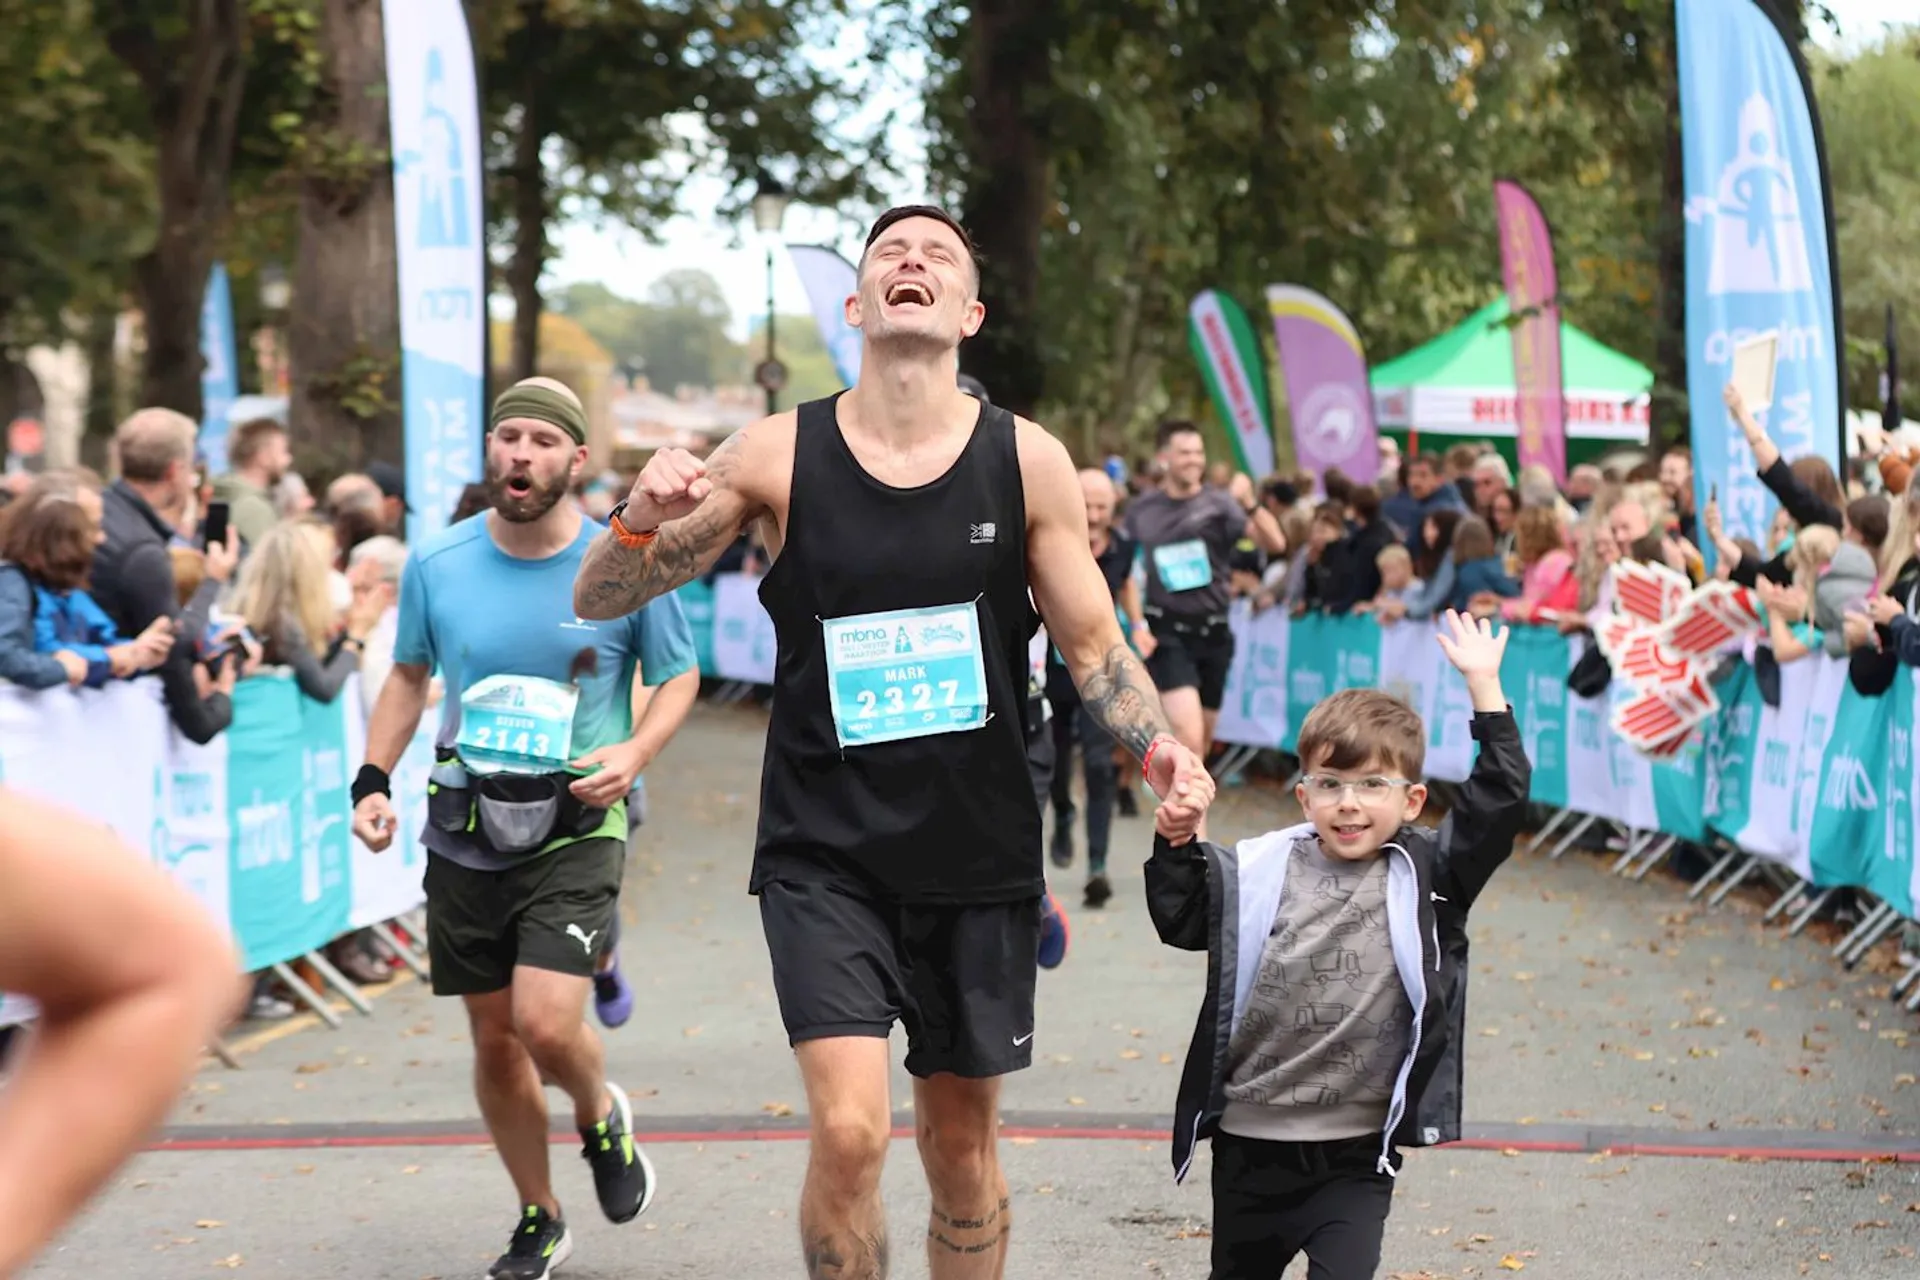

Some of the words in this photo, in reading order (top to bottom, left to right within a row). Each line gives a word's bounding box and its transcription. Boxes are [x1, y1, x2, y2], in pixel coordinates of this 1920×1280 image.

[840, 627, 887, 644] mbna
[884, 665, 927, 683] MARK
[857, 680, 959, 719] 2327
[476, 726, 550, 757] 2143
